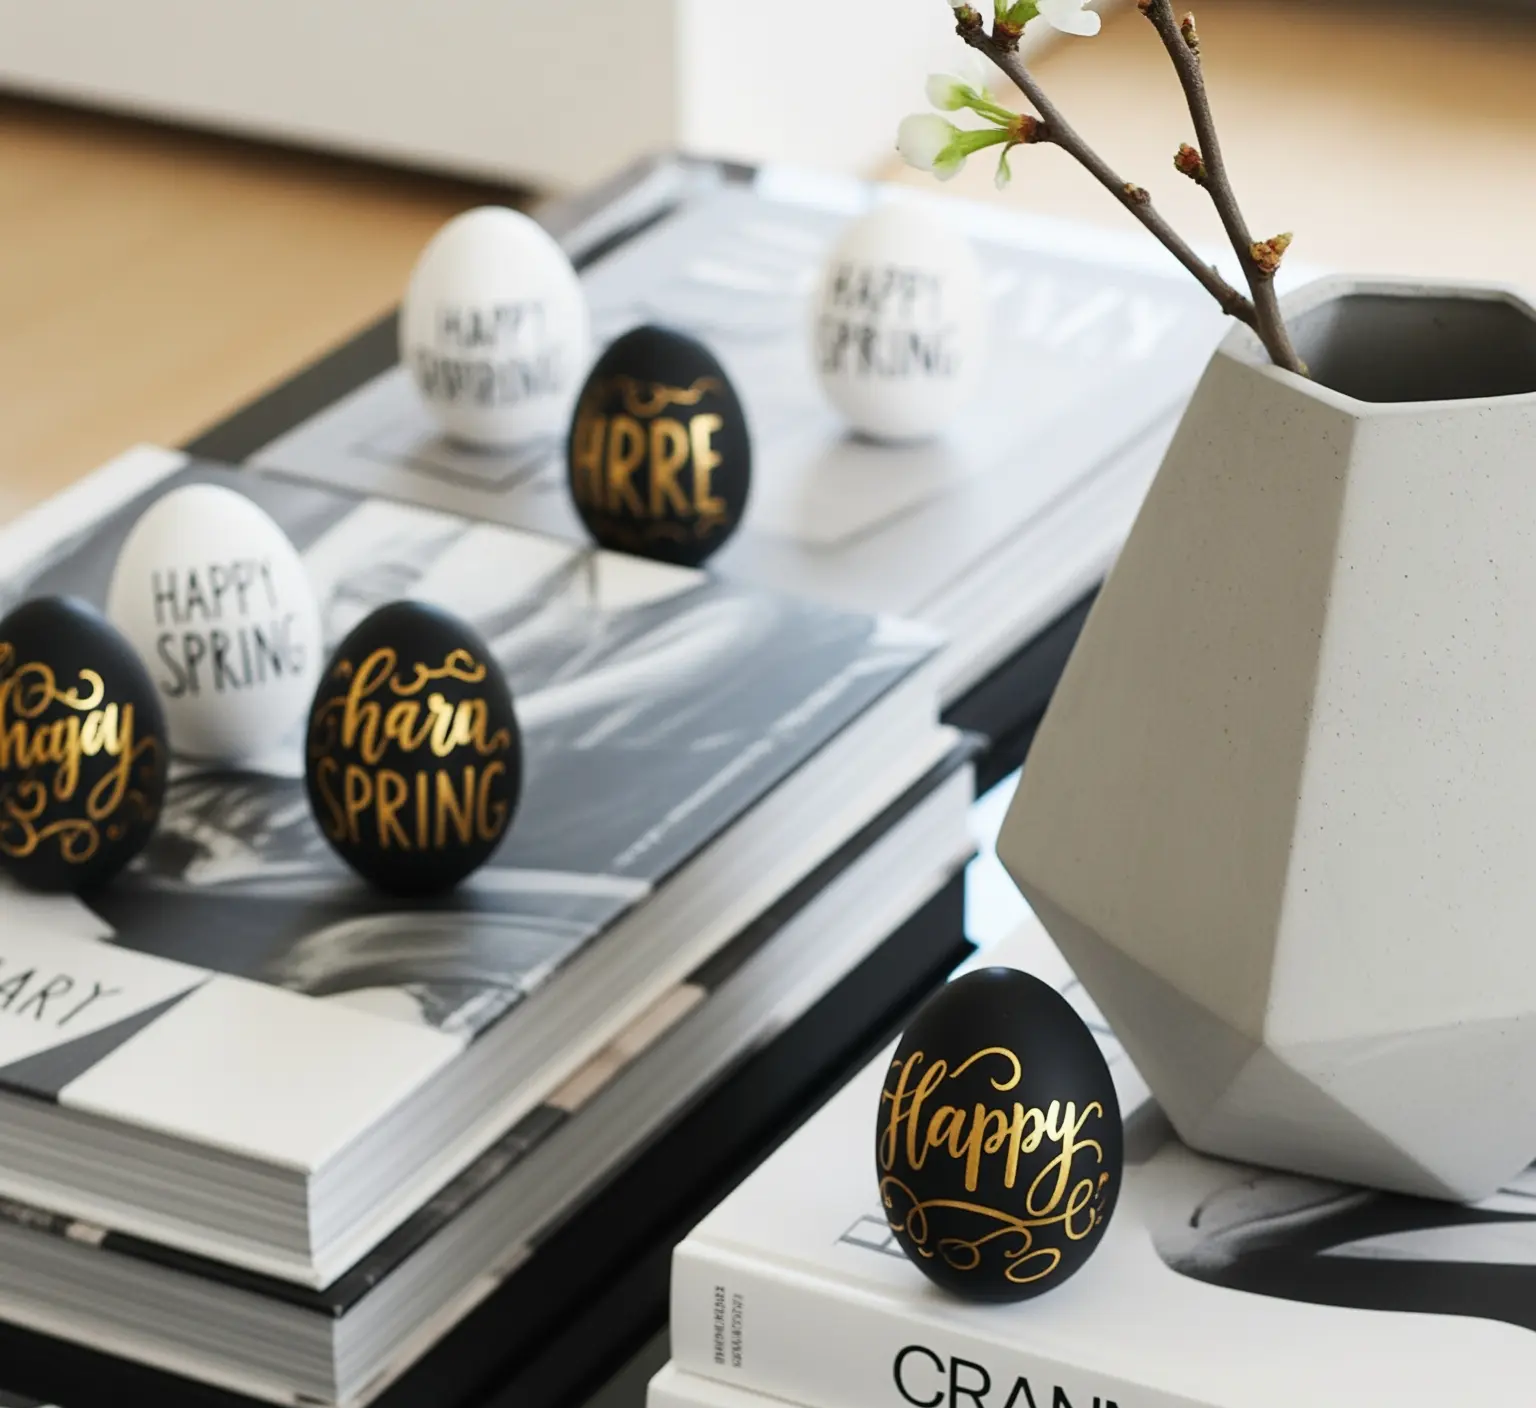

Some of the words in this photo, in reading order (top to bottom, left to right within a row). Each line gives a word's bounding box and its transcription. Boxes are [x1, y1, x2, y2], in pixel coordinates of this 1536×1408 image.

[152, 559, 277, 627] HAPPY
[157, 612, 306, 698] SPRING
[317, 756, 507, 850] SPRING
[0, 957, 123, 1028] ARY
[879, 1050, 1103, 1217] Happy
